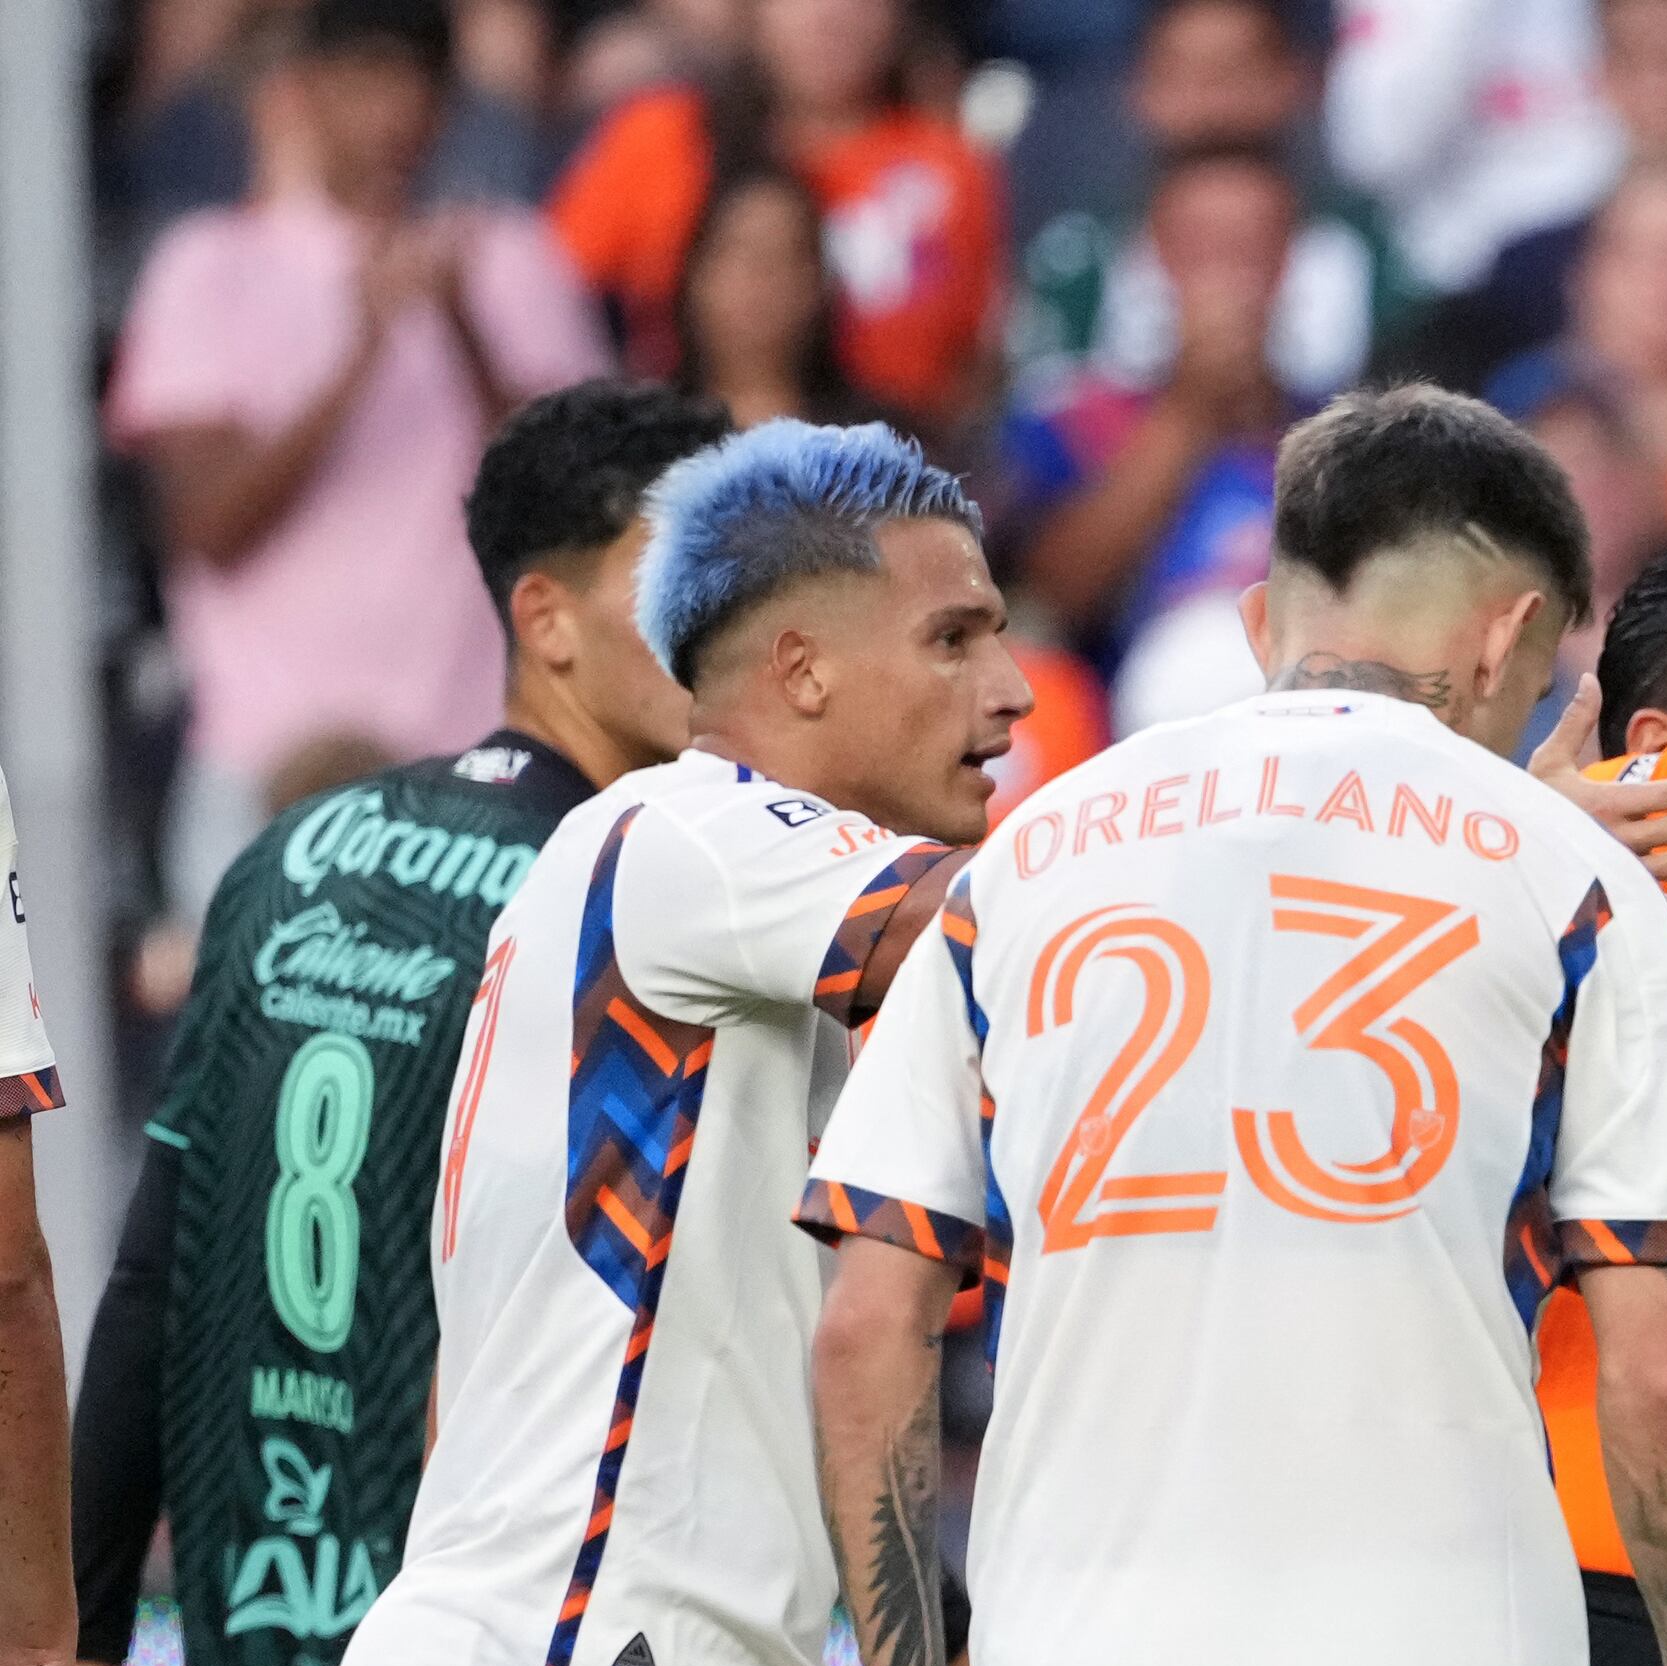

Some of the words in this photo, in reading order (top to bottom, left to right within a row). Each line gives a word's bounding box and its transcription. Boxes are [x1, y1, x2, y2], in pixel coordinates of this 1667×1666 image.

[282, 785, 539, 906] Corona
[1014, 755, 1520, 881] ORELLANO
[1024, 873, 1481, 1255] 23
[265, 1032, 374, 1354] 8
